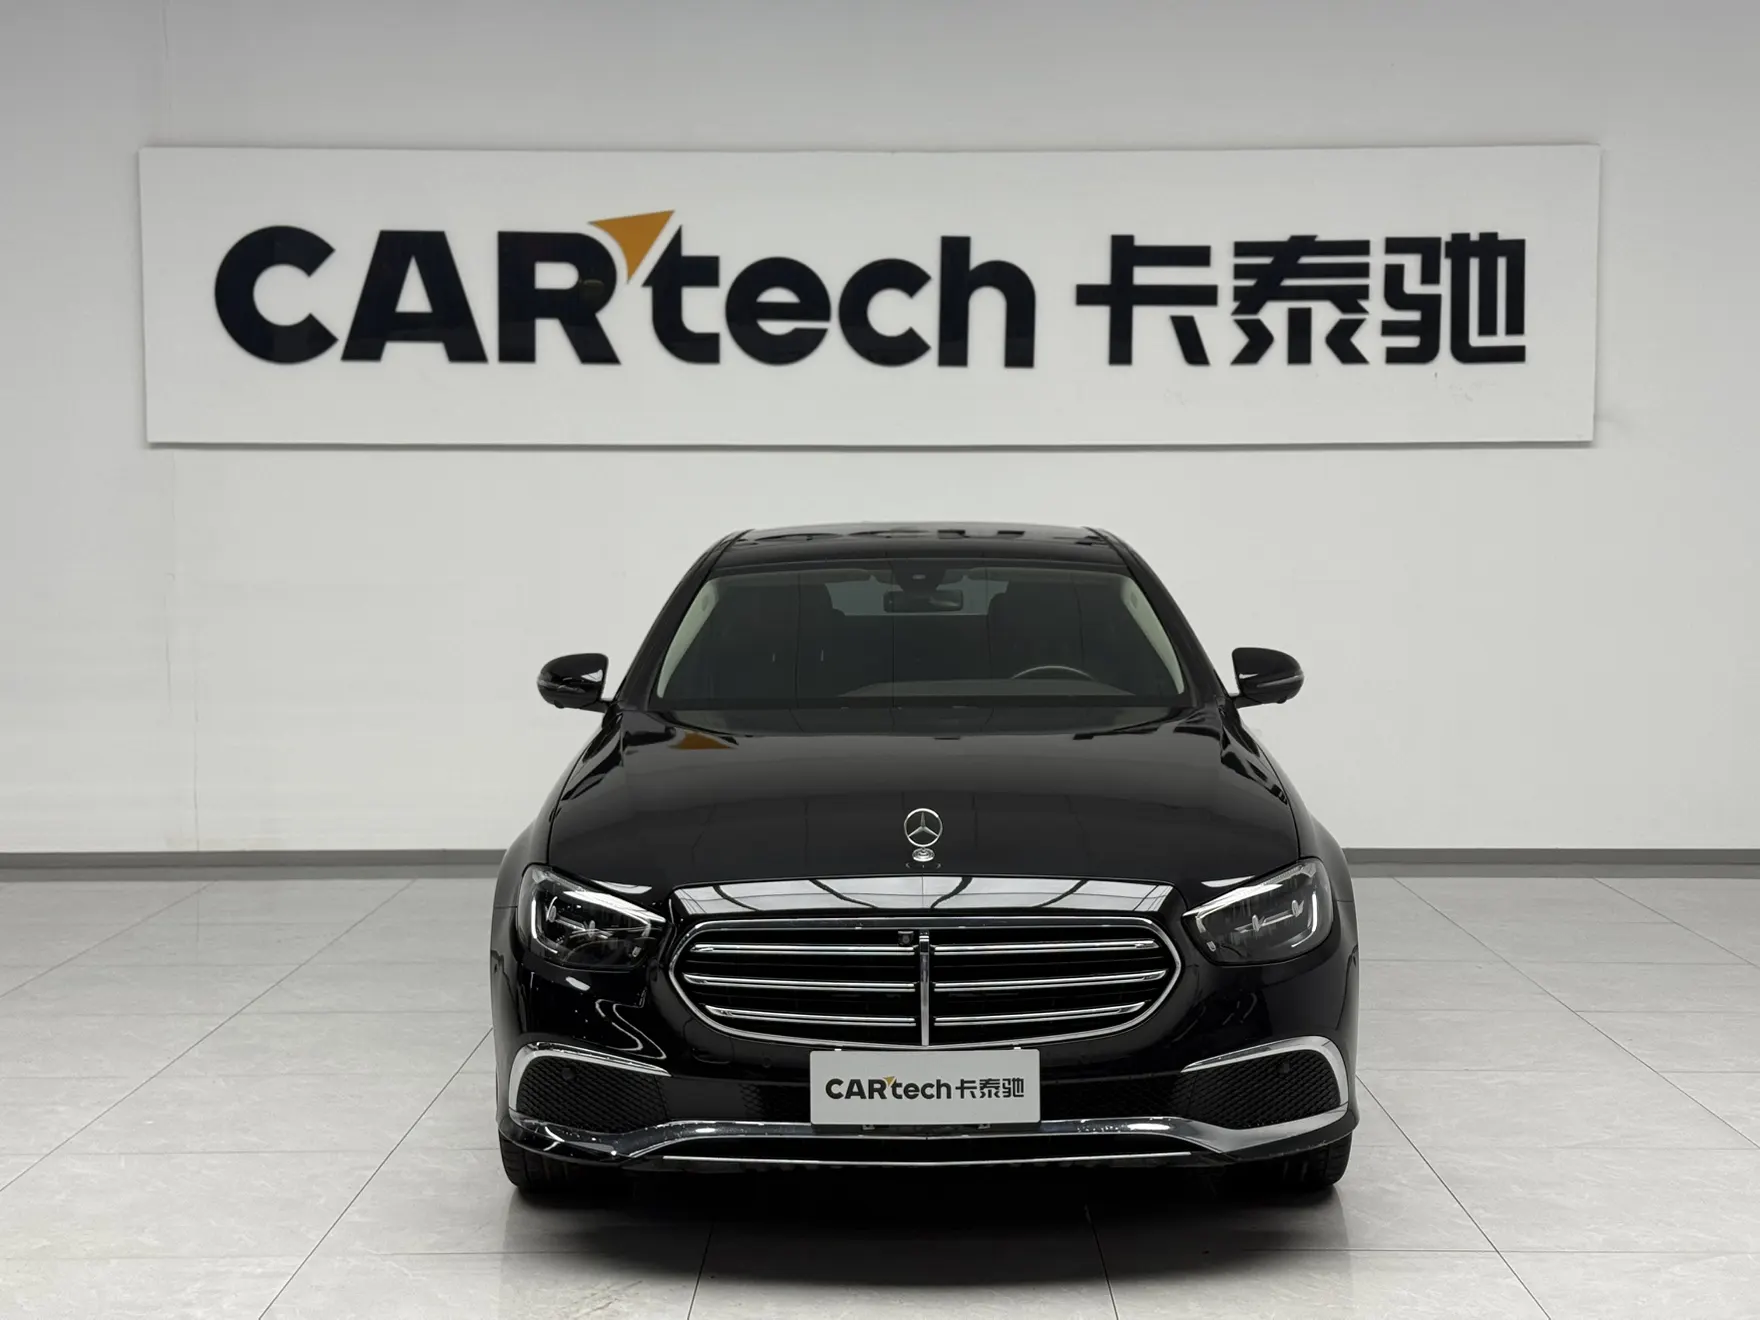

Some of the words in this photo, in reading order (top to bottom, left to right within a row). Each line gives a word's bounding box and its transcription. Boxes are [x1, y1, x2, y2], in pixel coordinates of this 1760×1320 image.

[215, 224, 1035, 367] CARtech
[1076, 232, 1526, 366] 卡泰驰
[825, 1077, 952, 1100] CARtech
[955, 1077, 1025, 1099] 卡泰驰
